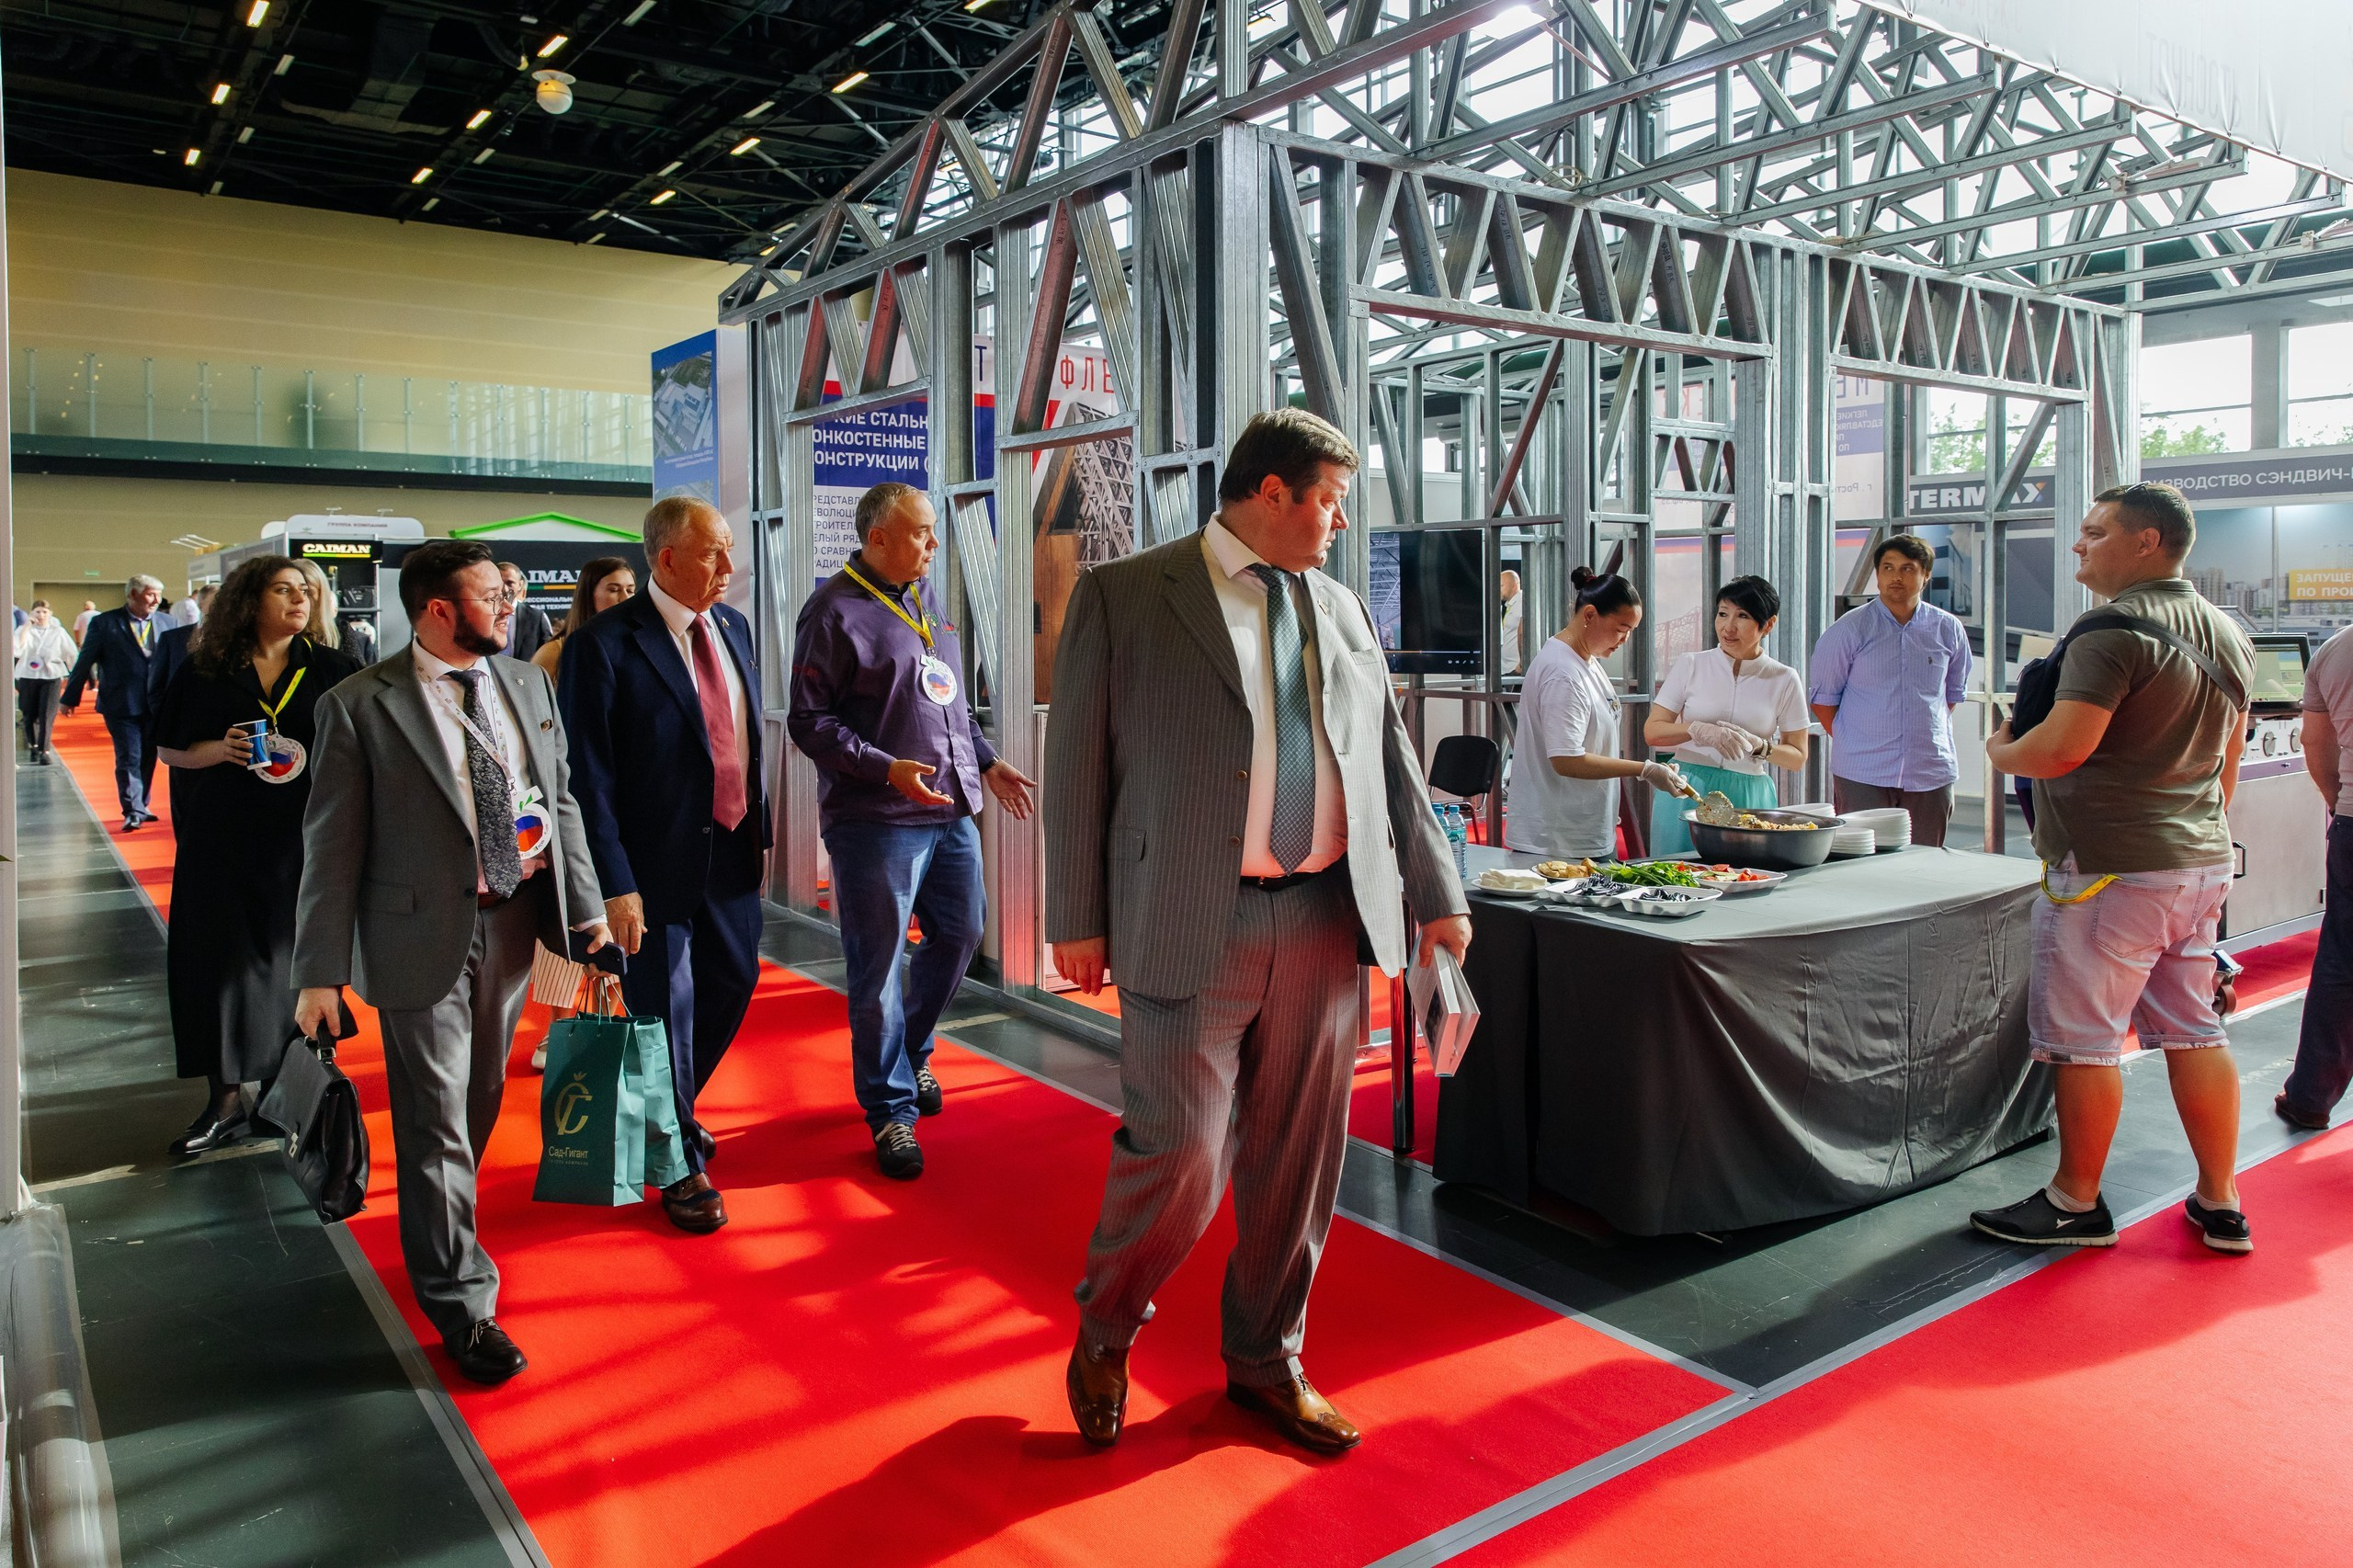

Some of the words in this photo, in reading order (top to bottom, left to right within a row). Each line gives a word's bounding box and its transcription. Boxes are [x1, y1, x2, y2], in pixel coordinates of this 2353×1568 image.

[813, 429, 926, 450] ОНКОСТЕННЫЕ
[813, 450, 919, 472] ОНСТРУКЦИИ
[2256, 467, 2353, 485] СЭНДВИЧ-
[302, 543, 371, 554] CAIMAN
[2296, 573, 2353, 584] ЗАПУЩЕ
[2297, 587, 2316, 597] ПО
[548, 1145, 588, 1159] Сад-Гигант
